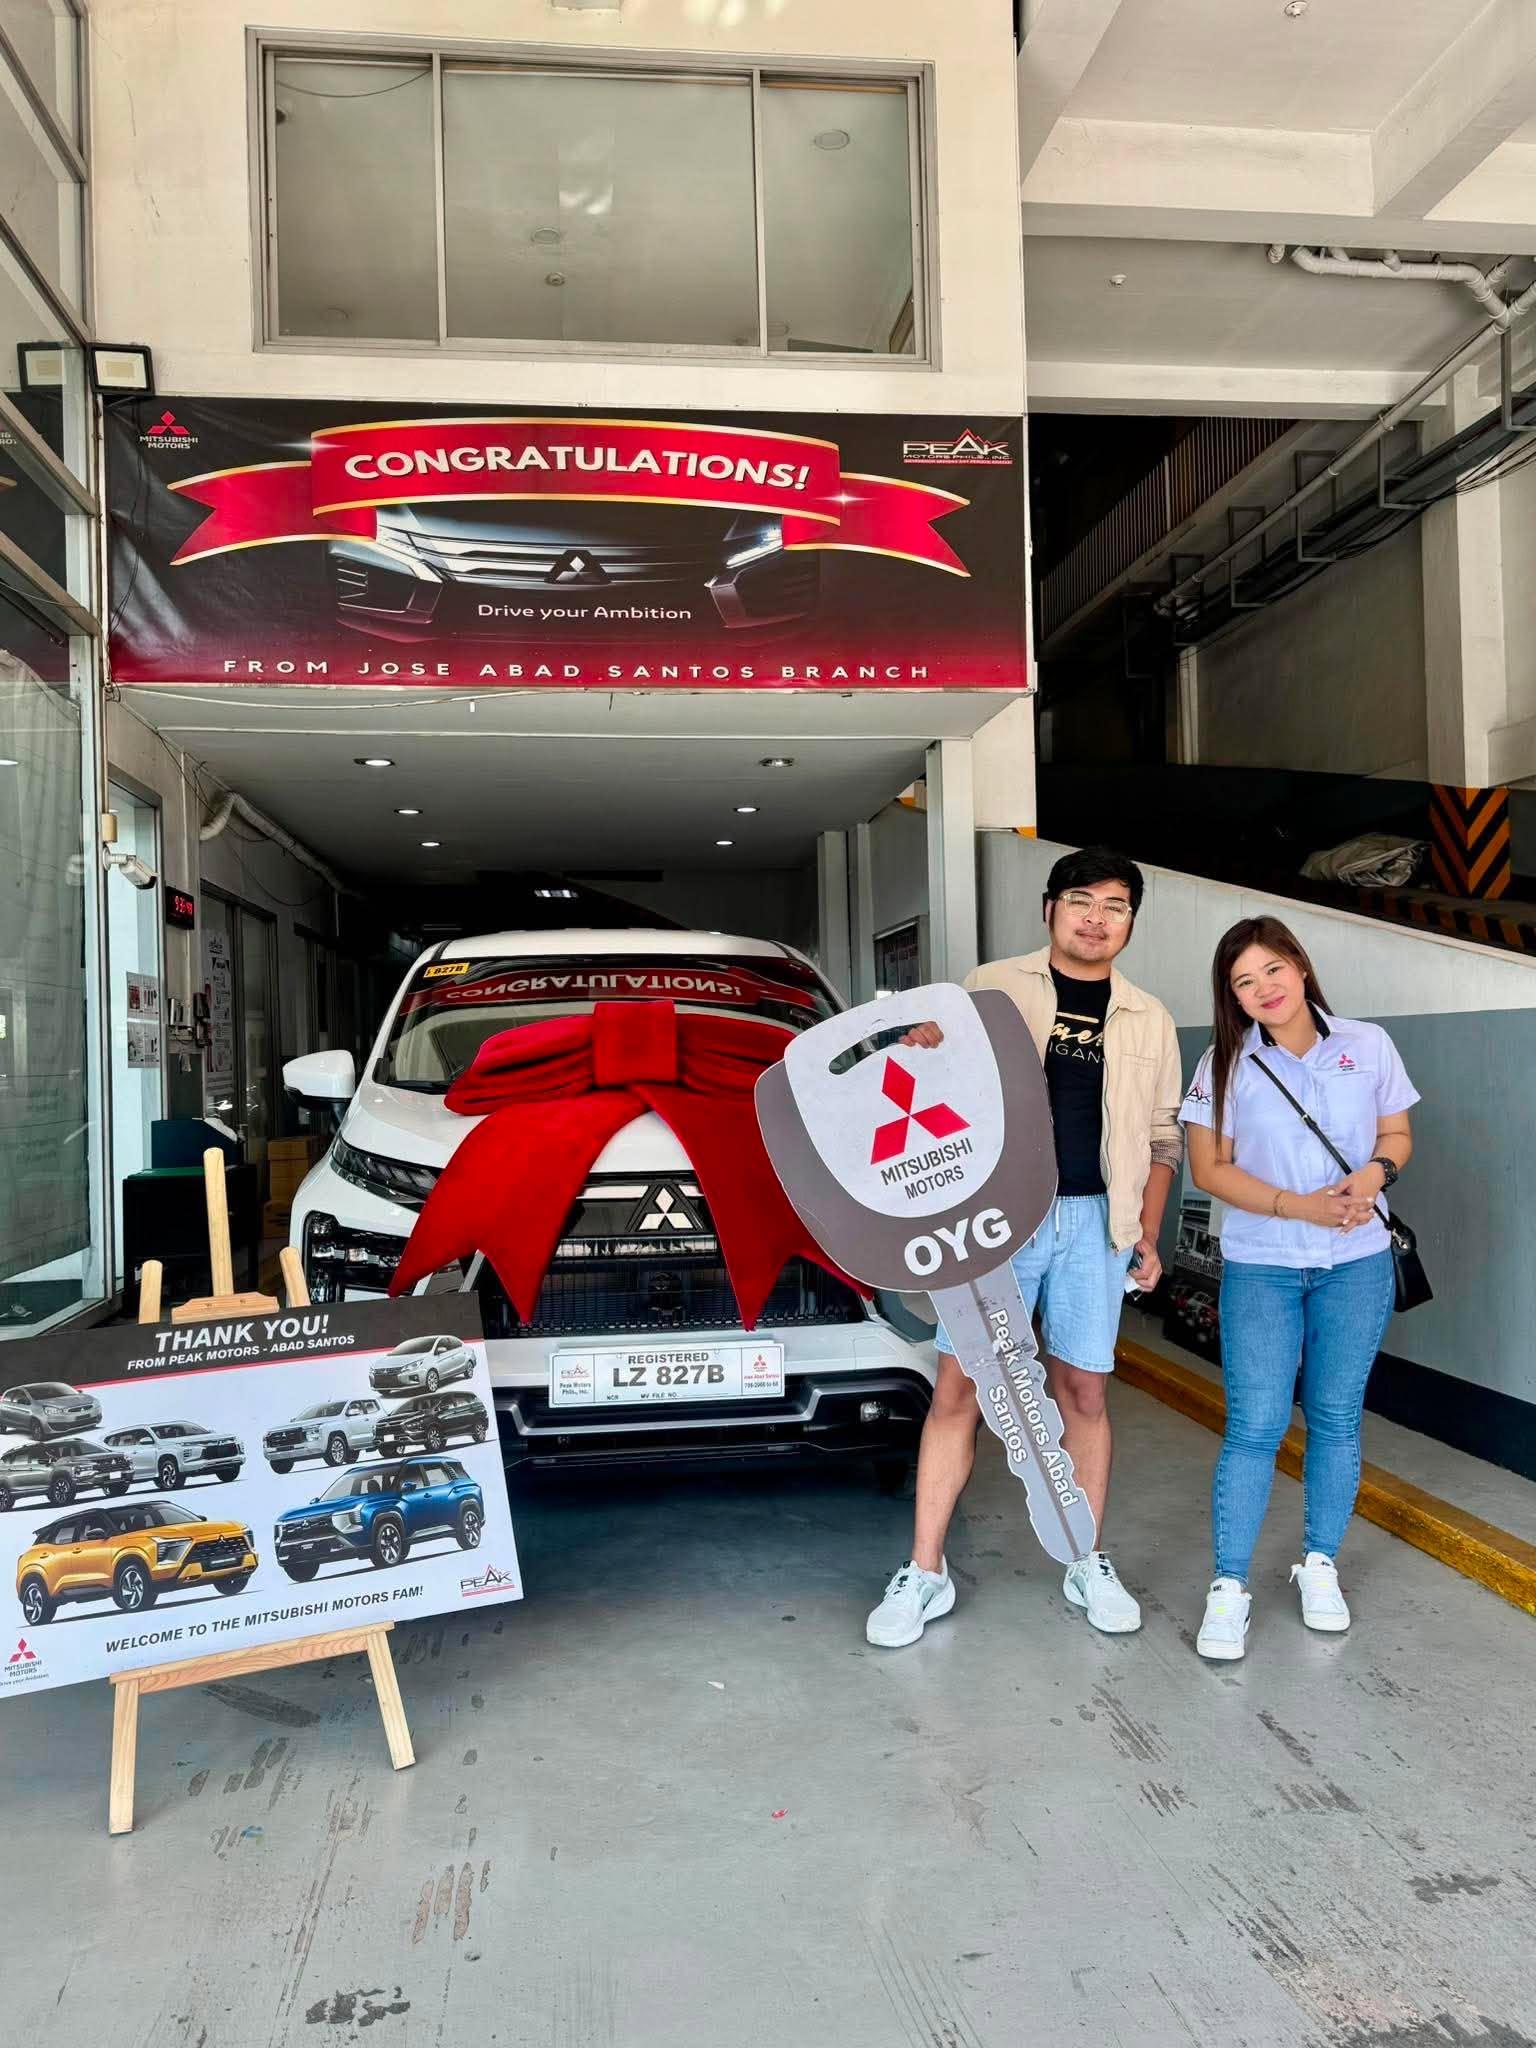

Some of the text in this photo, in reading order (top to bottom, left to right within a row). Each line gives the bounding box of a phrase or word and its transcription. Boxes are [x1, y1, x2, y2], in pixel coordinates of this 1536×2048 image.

[139, 435, 199, 444] MITSUBISHI
[147, 442, 191, 450] MOTORS
[903, 434, 1010, 456] PEAK
[345, 445, 810, 490] CONGRATULATIONS!
[477, 604, 692, 621] Drive your Ambition
[223, 660, 929, 680] FROM JOSE ABAD SANTOS BRANCH
[880, 1136, 974, 1187] MITSUBISHI
[904, 1164, 966, 1200] MOTORS
[903, 1206, 1014, 1277] OYG
[154, 1313, 330, 1353] THANK YOU!
[126, 1356, 167, 1371] FROM
[168, 1352, 204, 1366] PEAK
[205, 1345, 261, 1361] MOTORS
[270, 1340, 304, 1353] ABAD
[306, 1334, 356, 1349] SANTOS
[628, 1351, 710, 1365] REGISTERED
[612, 1364, 726, 1388] LZ 827B
[988, 1308, 1079, 1510] Peak Motors Abad
[988, 1384, 1028, 1464] Santos
[460, 1569, 513, 1591] PEAK
[105, 1585, 424, 1654] WELCOME TO THE MITSUBISHI MOTORS FAM!
[4, 1659, 43, 1673] MITSUBISHI
[9, 1666, 38, 1678] MOTORS
